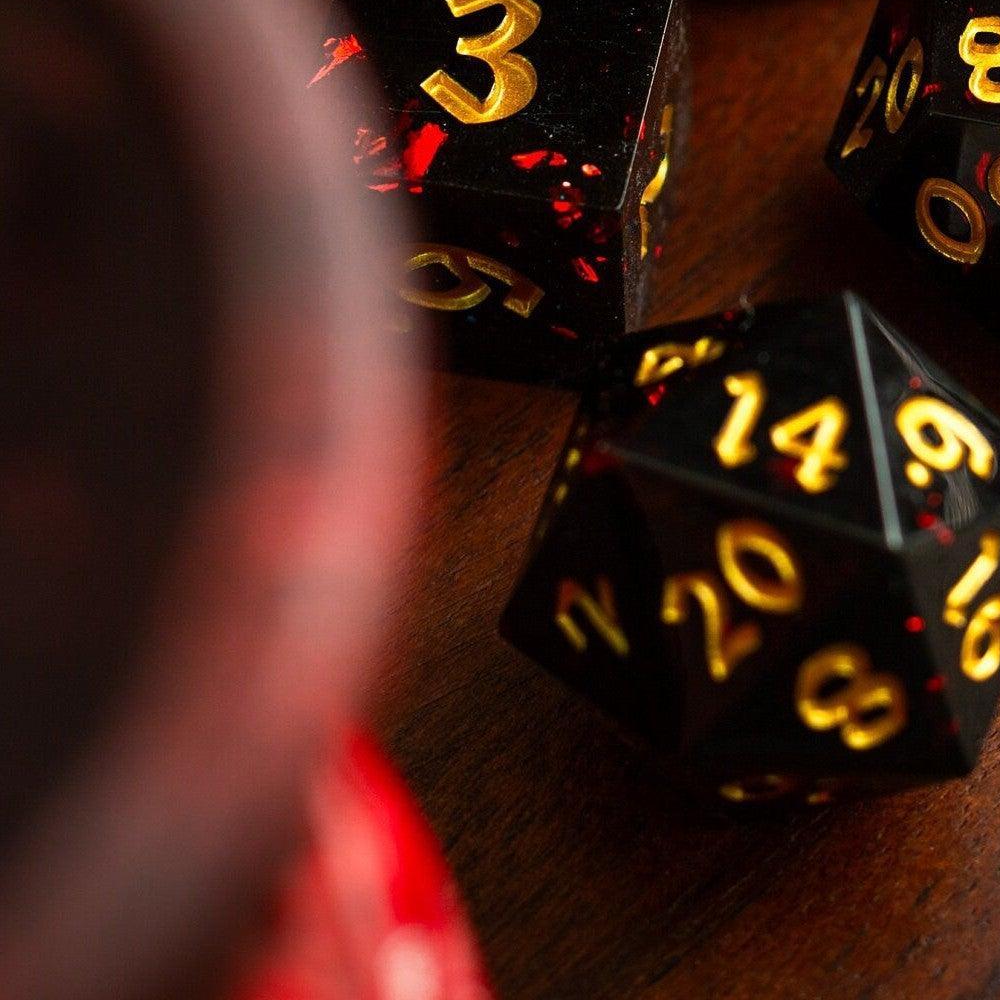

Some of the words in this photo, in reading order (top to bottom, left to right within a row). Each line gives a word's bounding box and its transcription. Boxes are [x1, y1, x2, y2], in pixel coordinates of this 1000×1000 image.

[839, 36, 925, 159] 20
[714, 369, 851, 494] 14
[659, 514, 806, 684] 20
[793, 640, 909, 751] 8
